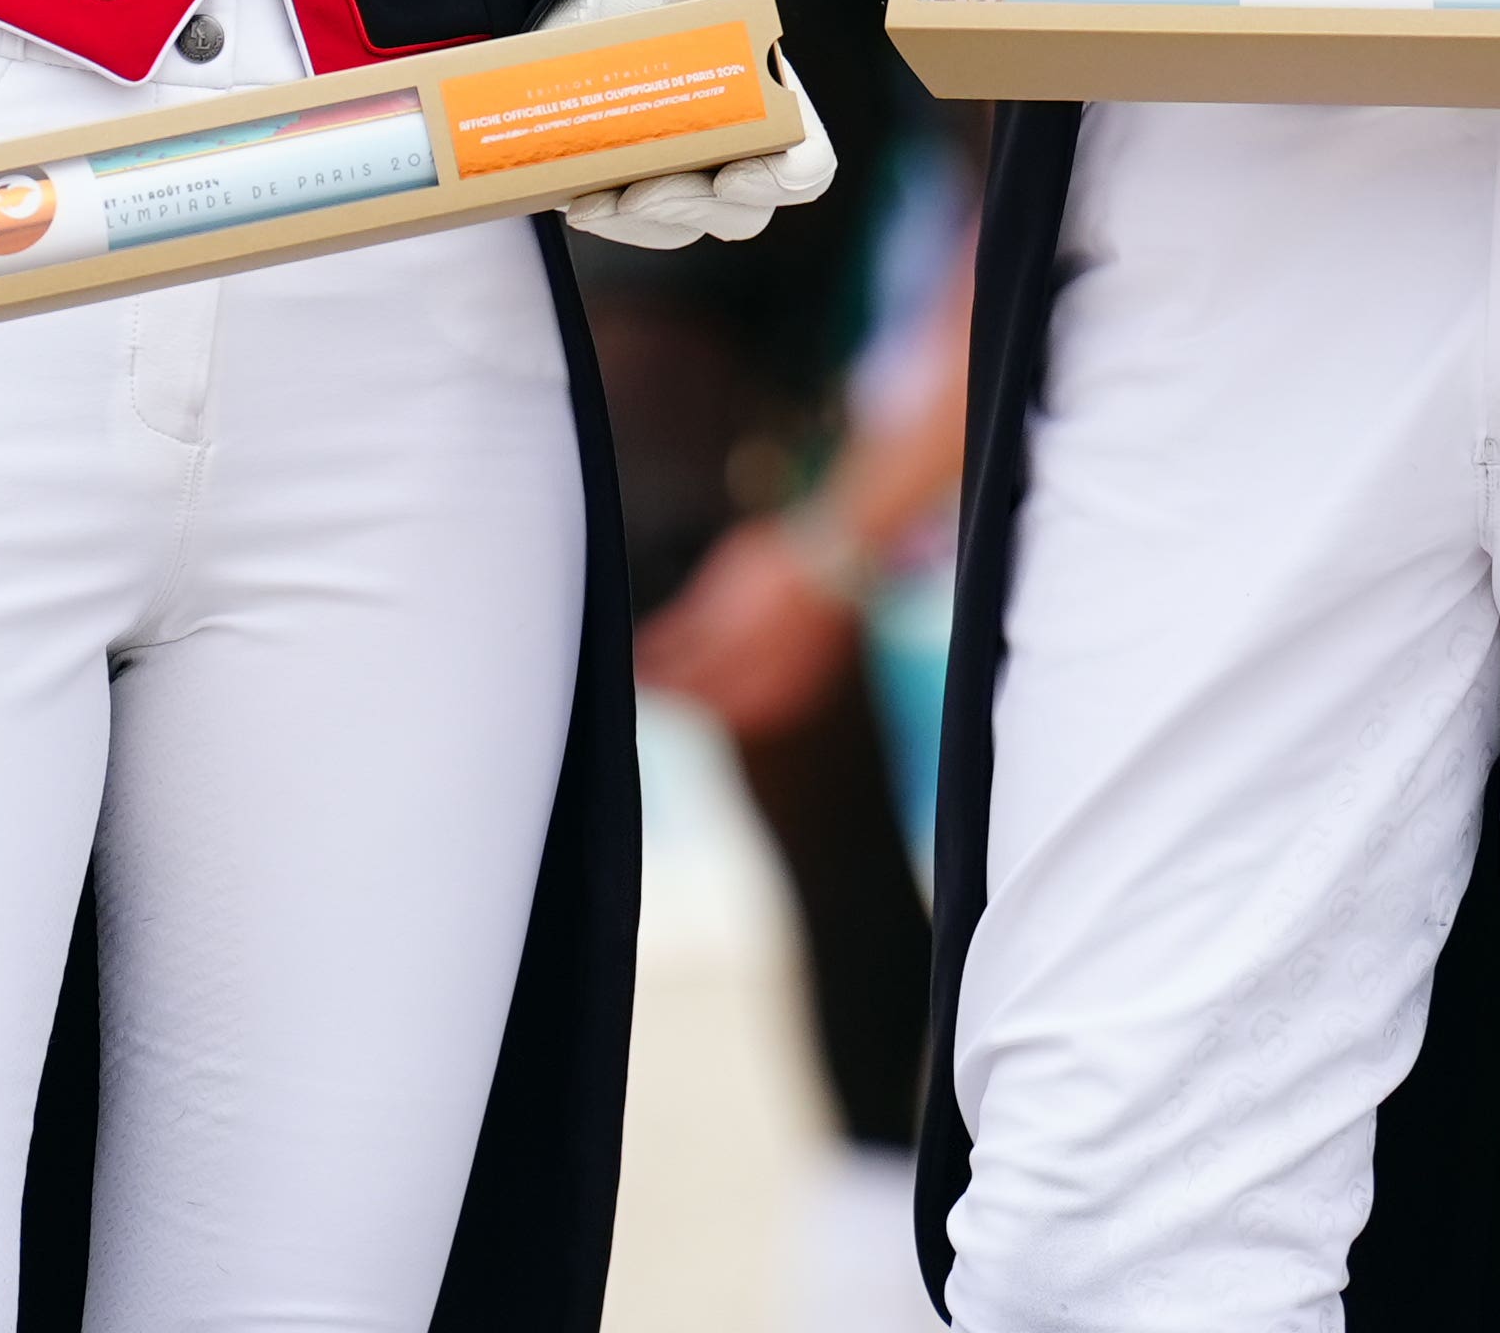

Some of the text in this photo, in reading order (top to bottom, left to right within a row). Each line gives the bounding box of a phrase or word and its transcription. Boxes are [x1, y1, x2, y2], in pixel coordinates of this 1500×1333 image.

[459, 64, 745, 131] AFFICHE OFFICIELLE DES JEUX OLYMPIQUES DE PARIS 2024
[148, 184, 182, 201] AOÛT
[186, 179, 220, 194] 2024
[252, 182, 279, 199] DE
[298, 162, 373, 189] PARIS
